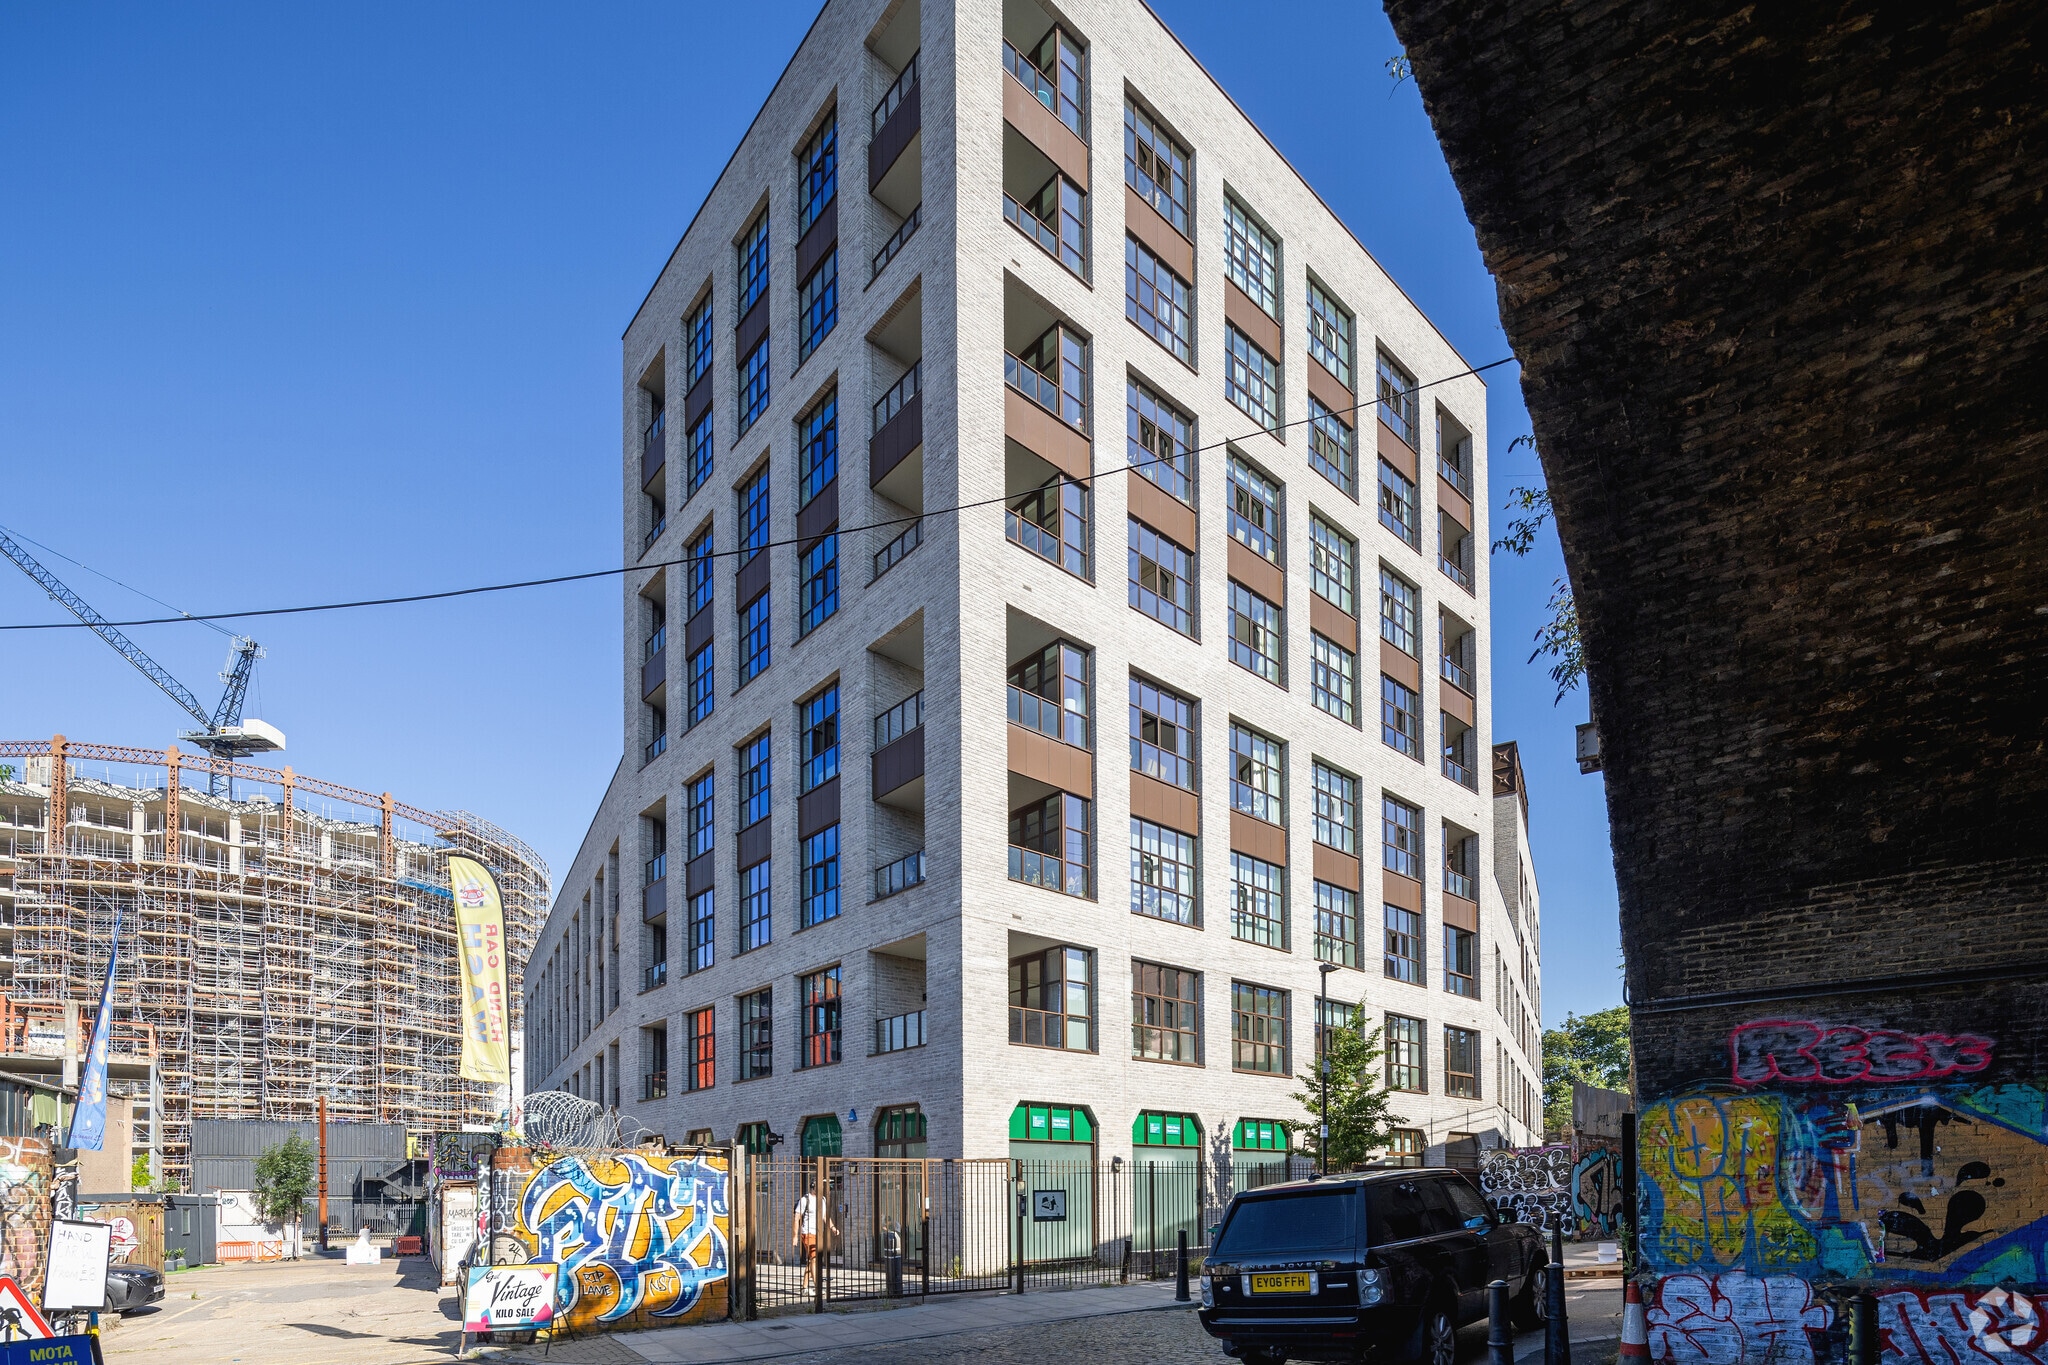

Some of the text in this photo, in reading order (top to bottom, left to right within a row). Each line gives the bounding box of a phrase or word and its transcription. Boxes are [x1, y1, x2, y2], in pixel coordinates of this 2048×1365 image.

[57, 1229, 93, 1243] HAND
[1280, 1261, 1322, 1269] ROVER
[582, 1270, 605, 1283] RIP
[1256, 1276, 1305, 1288] EY06 FFH
[490, 1274, 543, 1308] Vintage
[495, 1307, 535, 1318] KILO SALE
[30, 1345, 73, 1362] MOTA
